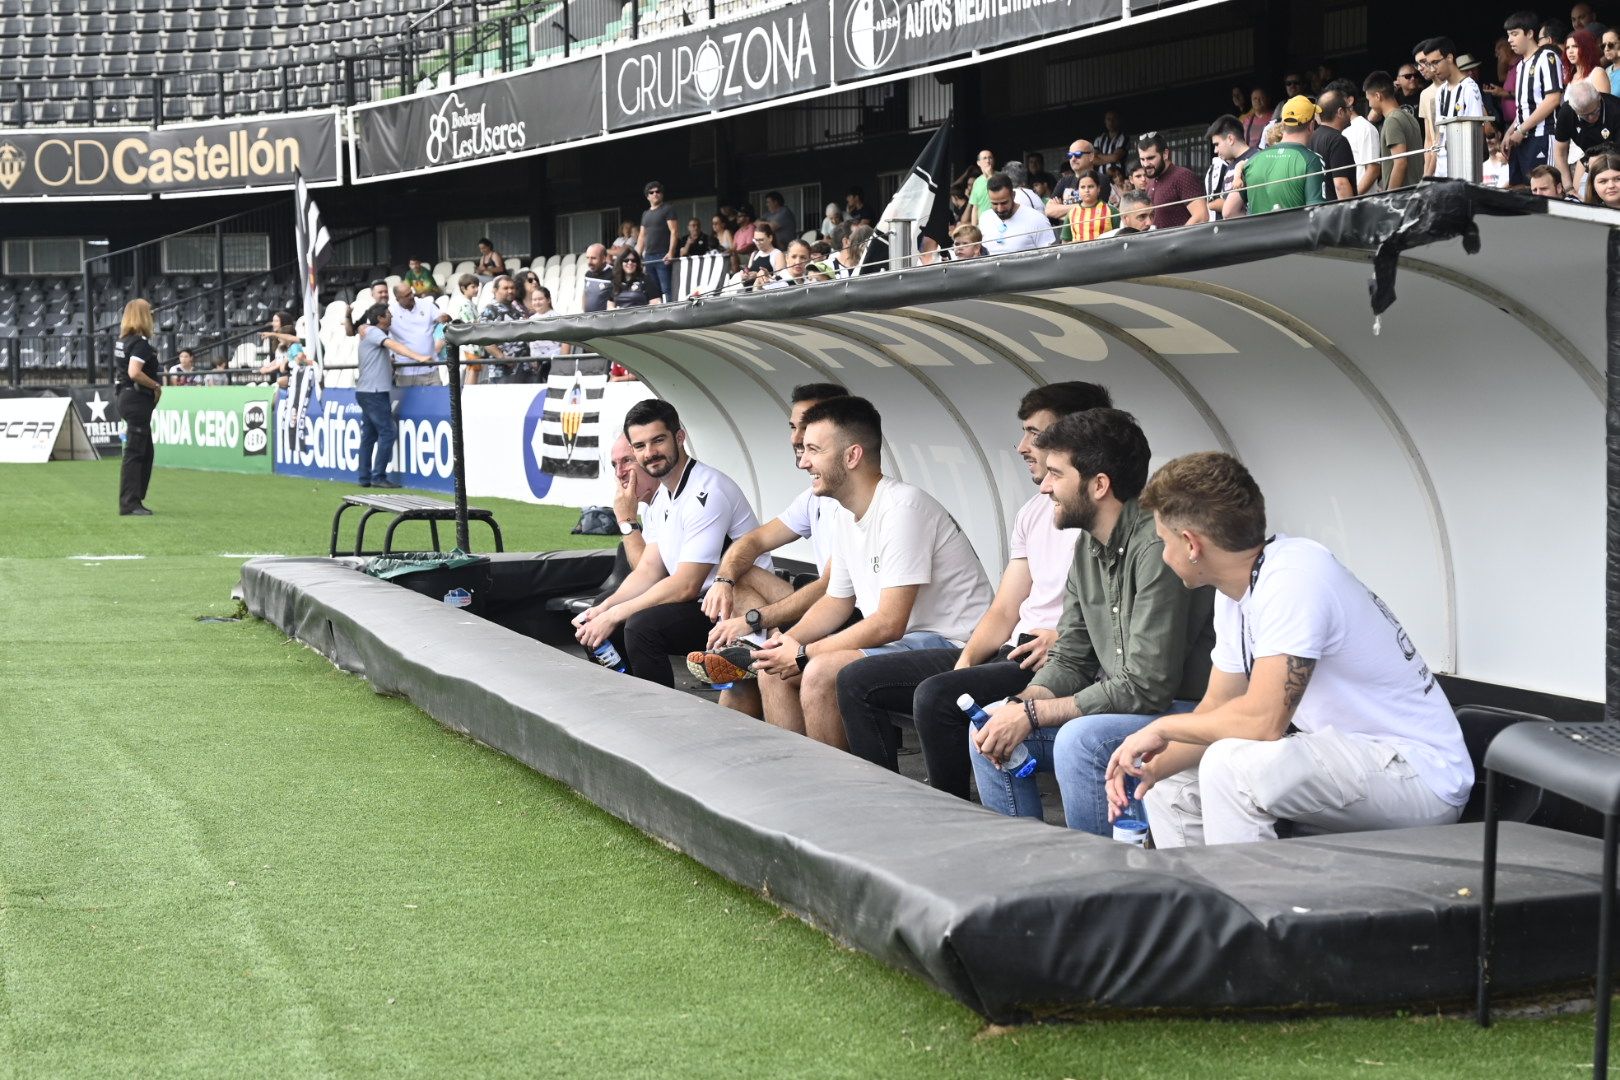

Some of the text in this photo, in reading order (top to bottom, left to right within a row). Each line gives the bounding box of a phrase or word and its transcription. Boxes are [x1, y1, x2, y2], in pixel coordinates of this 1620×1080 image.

[904, 0, 952, 40] AUTOS
[149, 408, 192, 446] ONDA
[194, 409, 239, 448] CERO
